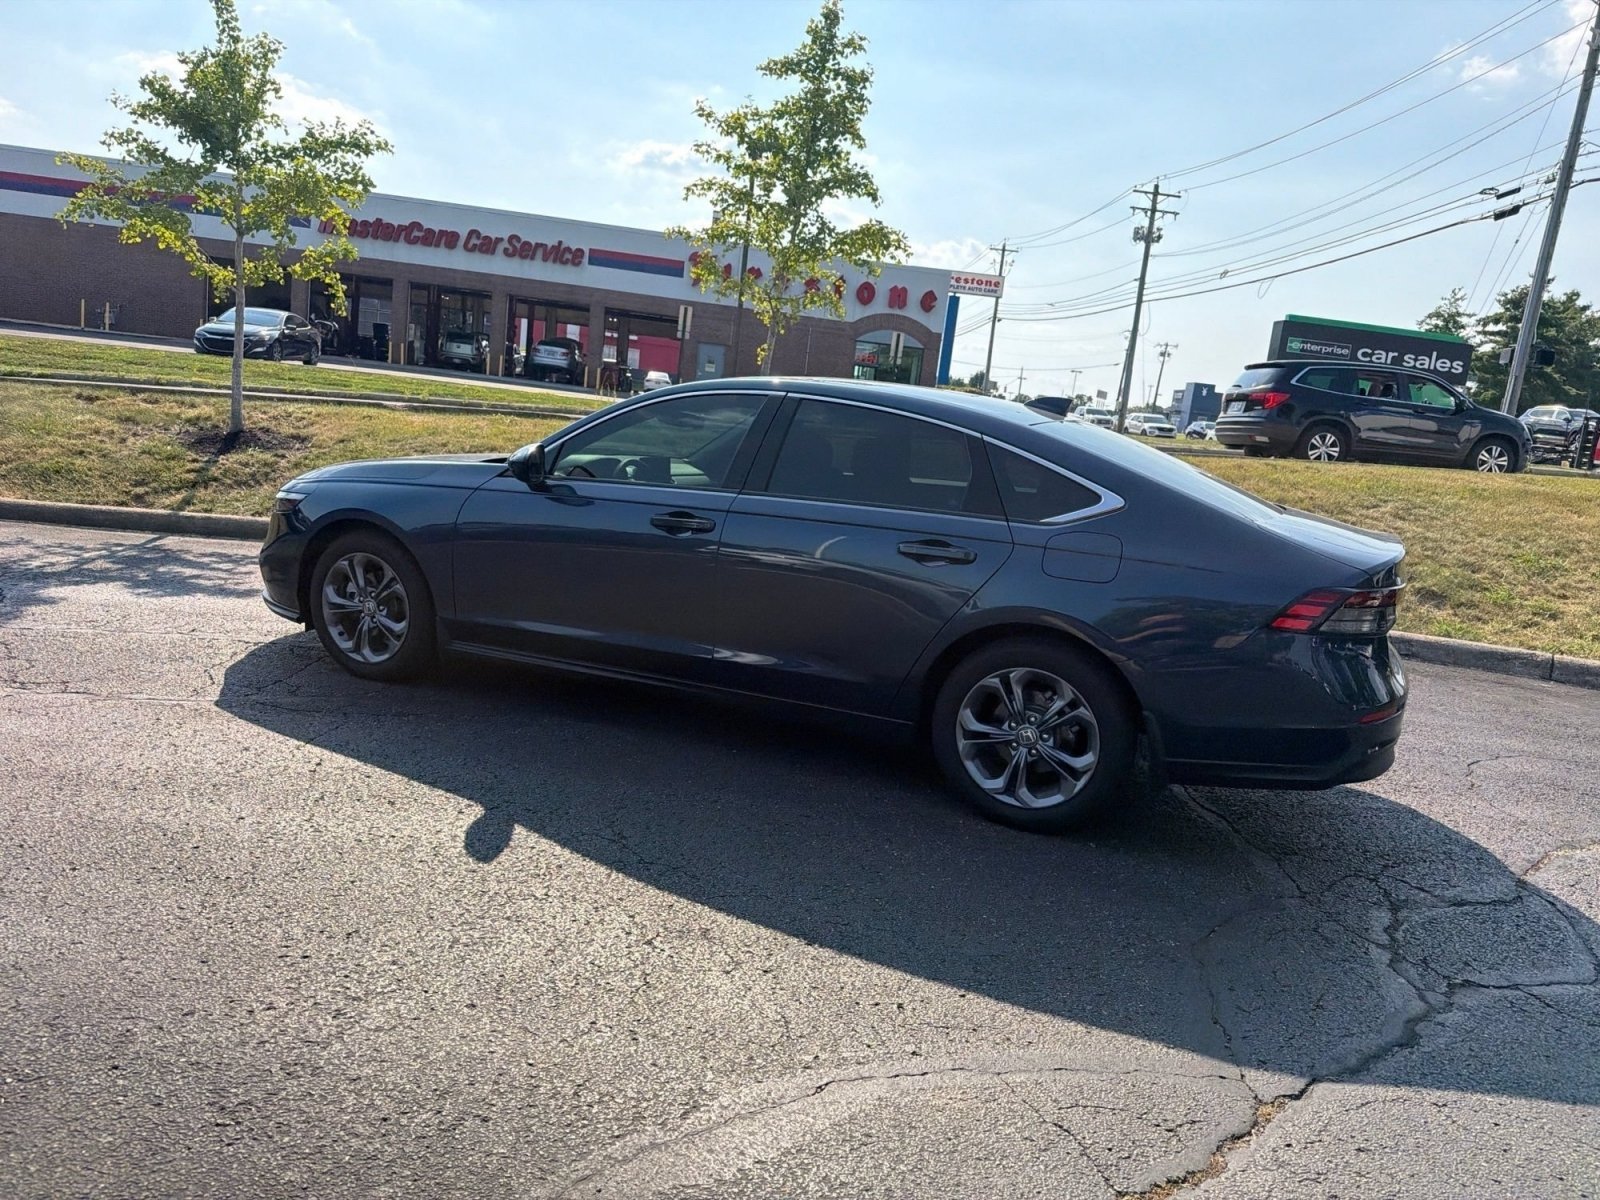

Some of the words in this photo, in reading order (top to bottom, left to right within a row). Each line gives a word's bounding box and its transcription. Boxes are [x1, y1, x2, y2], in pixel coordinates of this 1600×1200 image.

[463, 229, 504, 256] Car
[503, 234, 585, 267] Service
[1289, 341, 1349, 355] enterprise
[1357, 347, 1398, 364] car
[1402, 351, 1464, 374] sales
